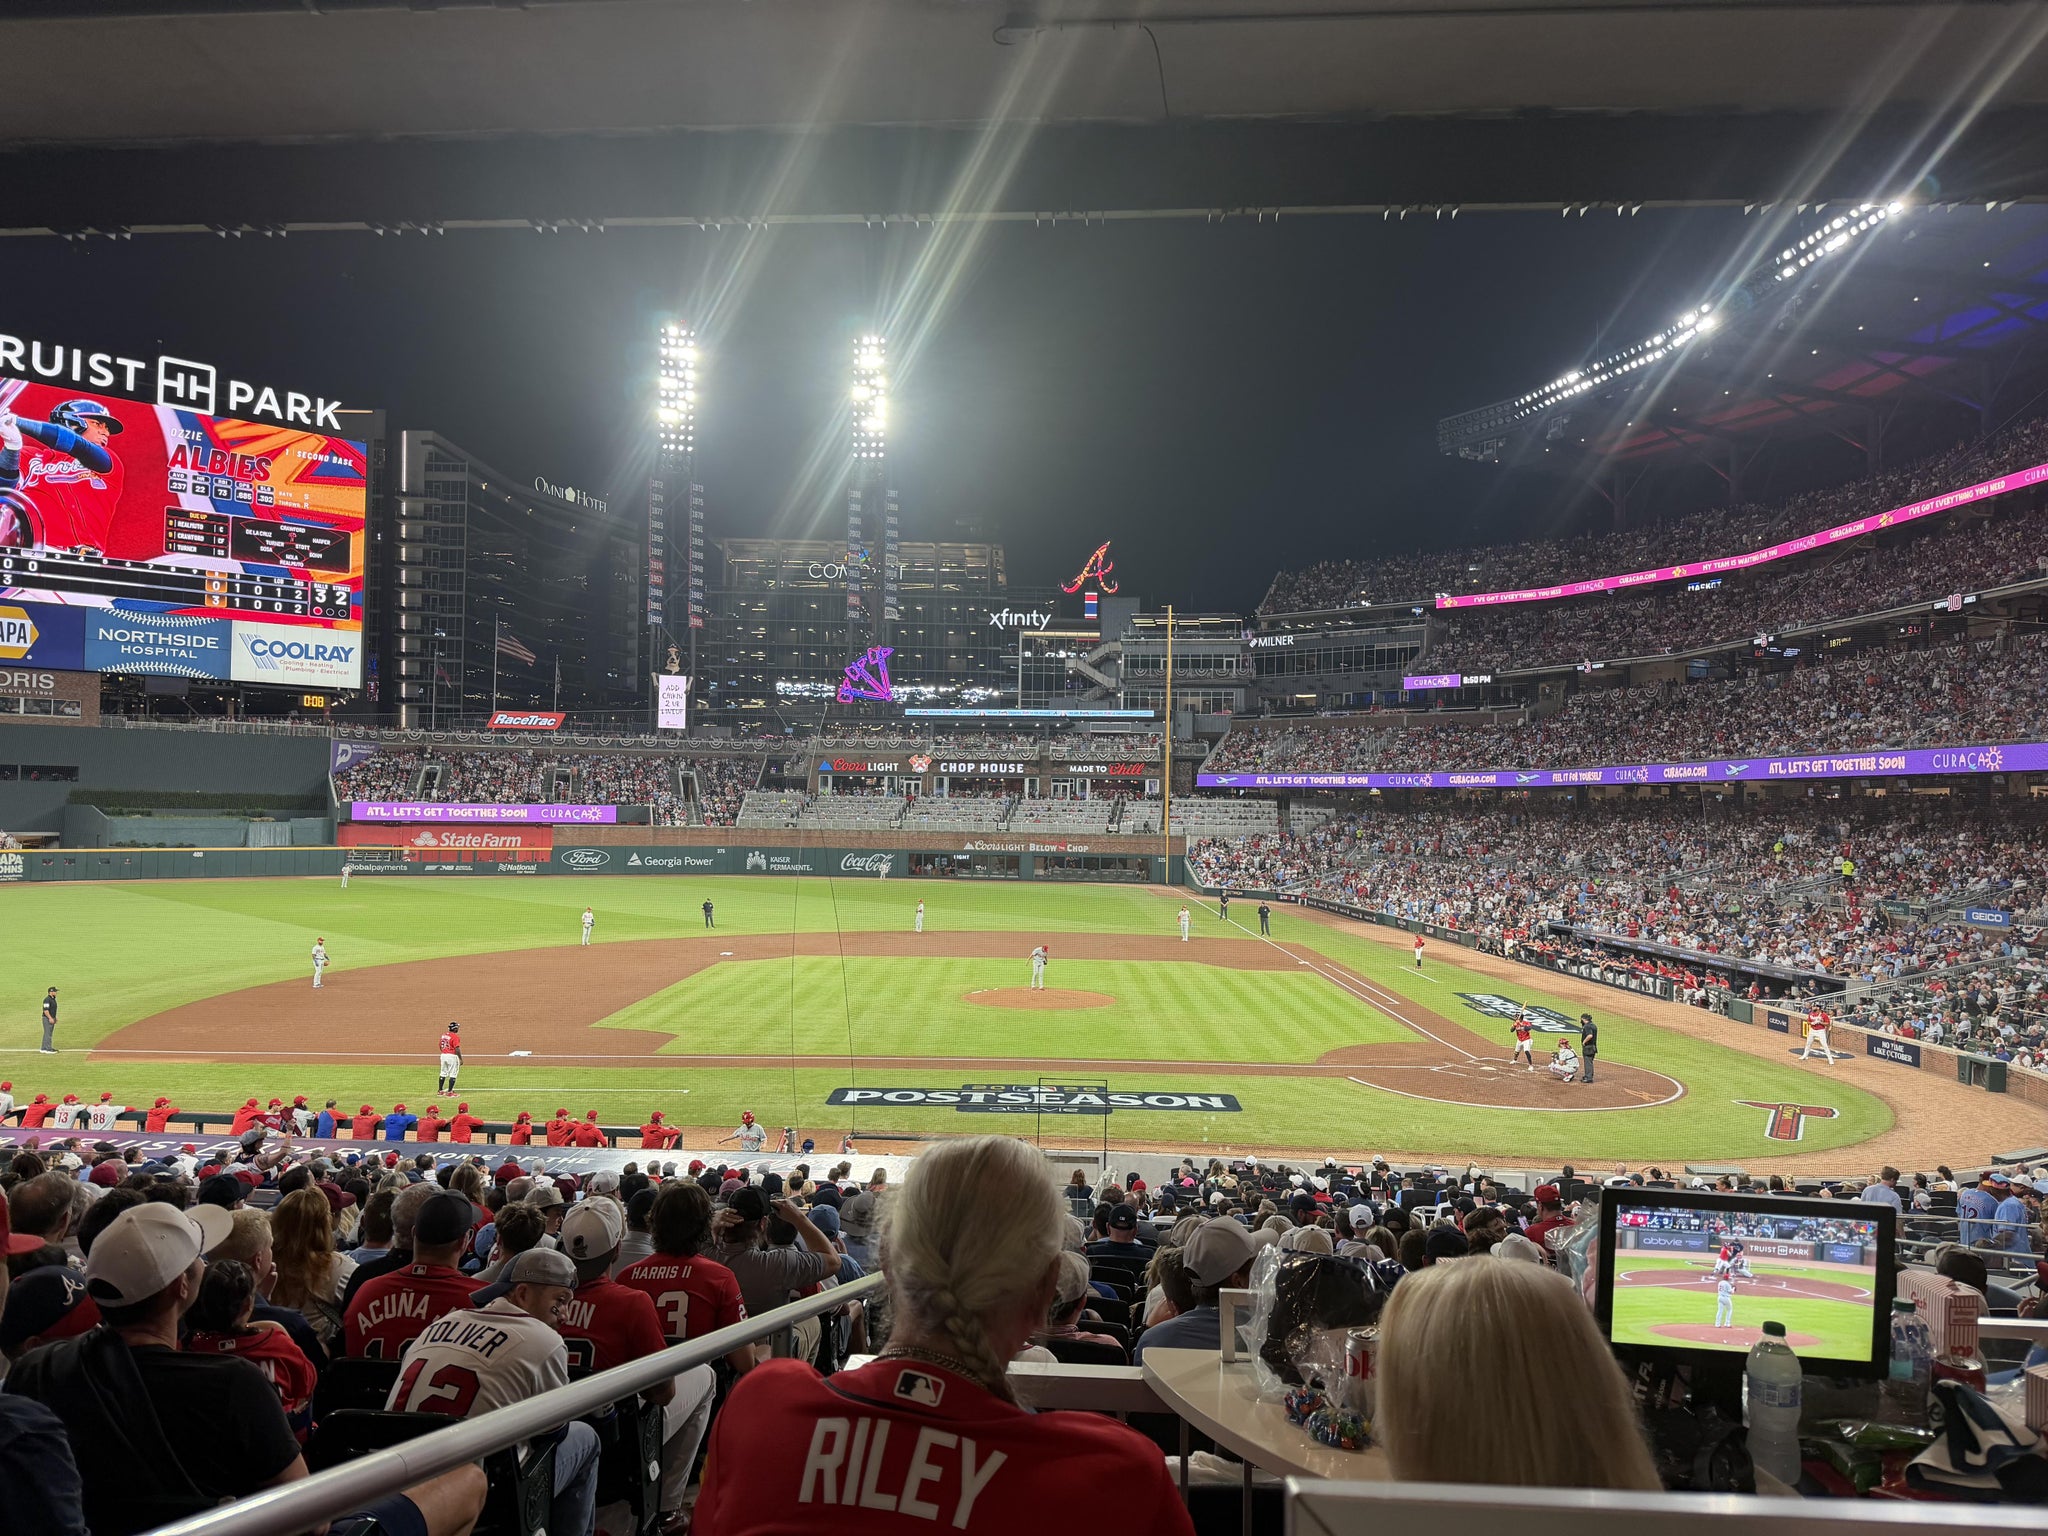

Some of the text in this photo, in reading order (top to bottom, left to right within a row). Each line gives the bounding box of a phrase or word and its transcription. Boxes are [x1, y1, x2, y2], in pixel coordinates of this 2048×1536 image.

[0, 334, 343, 431] RUIST PARK
[170, 428, 203, 442] OZZIE
[167, 444, 273, 482] ALBIES
[296, 450, 330, 462] SECOND
[333, 456, 354, 467] BASE
[170, 482, 228, 497] .237 22 73
[535, 476, 564, 499] OMNI
[1921, 501, 1934, 513] GOT
[1936, 490, 1973, 508] EVERYTHING
[1975, 485, 1988, 496] YOU
[1990, 480, 2006, 492] NEED
[1703, 563, 1711, 571] MY
[1714, 560, 1730, 569] TEAM
[1731, 559, 1736, 567] IS
[1769, 549, 1778, 558] YOU
[4, 558, 302, 600] 0 0 0 1 0 1 2
[3, 574, 302, 614] 3 3 1 0 0 2
[315, 588, 347, 606] 3 2
[1948, 594, 1961, 611] 10
[990, 608, 1052, 631] xfinity
[99, 628, 219, 649] NORTHSIDE
[1258, 635, 1294, 647] MILNER
[121, 645, 198, 659] HOSPITAL
[250, 638, 355, 663] COOLRAY
[1480, 675, 1491, 683] PM
[304, 695, 324, 707] 0:08
[494, 714, 556, 726] RaceTrac
[832, 758, 867, 772] Coors
[868, 763, 899, 772] LIGHT
[940, 762, 975, 773] CHOP
[981, 763, 1024, 773] HOUSE
[1108, 762, 1145, 775] Chill
[1769, 762, 1787, 774] ATL,
[1788, 761, 1810, 773] LET'S
[1812, 760, 1828, 773] GET
[1830, 757, 1877, 772] TOGETHER
[1879, 756, 1905, 769] SOON
[1273, 776, 1293, 784] LET'S
[1294, 776, 1307, 784] GET
[1309, 776, 1346, 784] TOGETHER
[1347, 776, 1368, 784] SOON
[1579, 771, 1602, 781] YOURSELF
[367, 806, 528, 818] ATL, LET'S GET TOGETHER SOON
[974, 840, 1089, 852] Coors LIGHT BELOW CHOP
[0, 853, 23, 864] APA
[570, 851, 602, 864] Ford
[644, 857, 714, 867] Georgia Power
[0, 865, 23, 873] OHNS
[1972, 912, 2002, 922] GEICO
[1769, 1018, 1787, 1027] abbvie
[1882, 1041, 1904, 1052] NO TIME
[1874, 1048, 1912, 1062] LIKE OCTOBER
[842, 1090, 1226, 1108] POSTSEASON
[57, 1112, 69, 1123] 13
[93, 1113, 105, 1124] 88
[1962, 1205, 1978, 1219] 12
[1643, 1237, 1682, 1246] abbvie
[1750, 1245, 1776, 1253] TRUIST
[631, 1264, 692, 1280] HARRIS II
[358, 1288, 431, 1335] ACUÑA
[422, 1319, 509, 1358] TOLIVER
[1344, 1350, 1376, 1380] ok
[393, 1358, 480, 1417] 12
[798, 1416, 1008, 1530] RILEY
